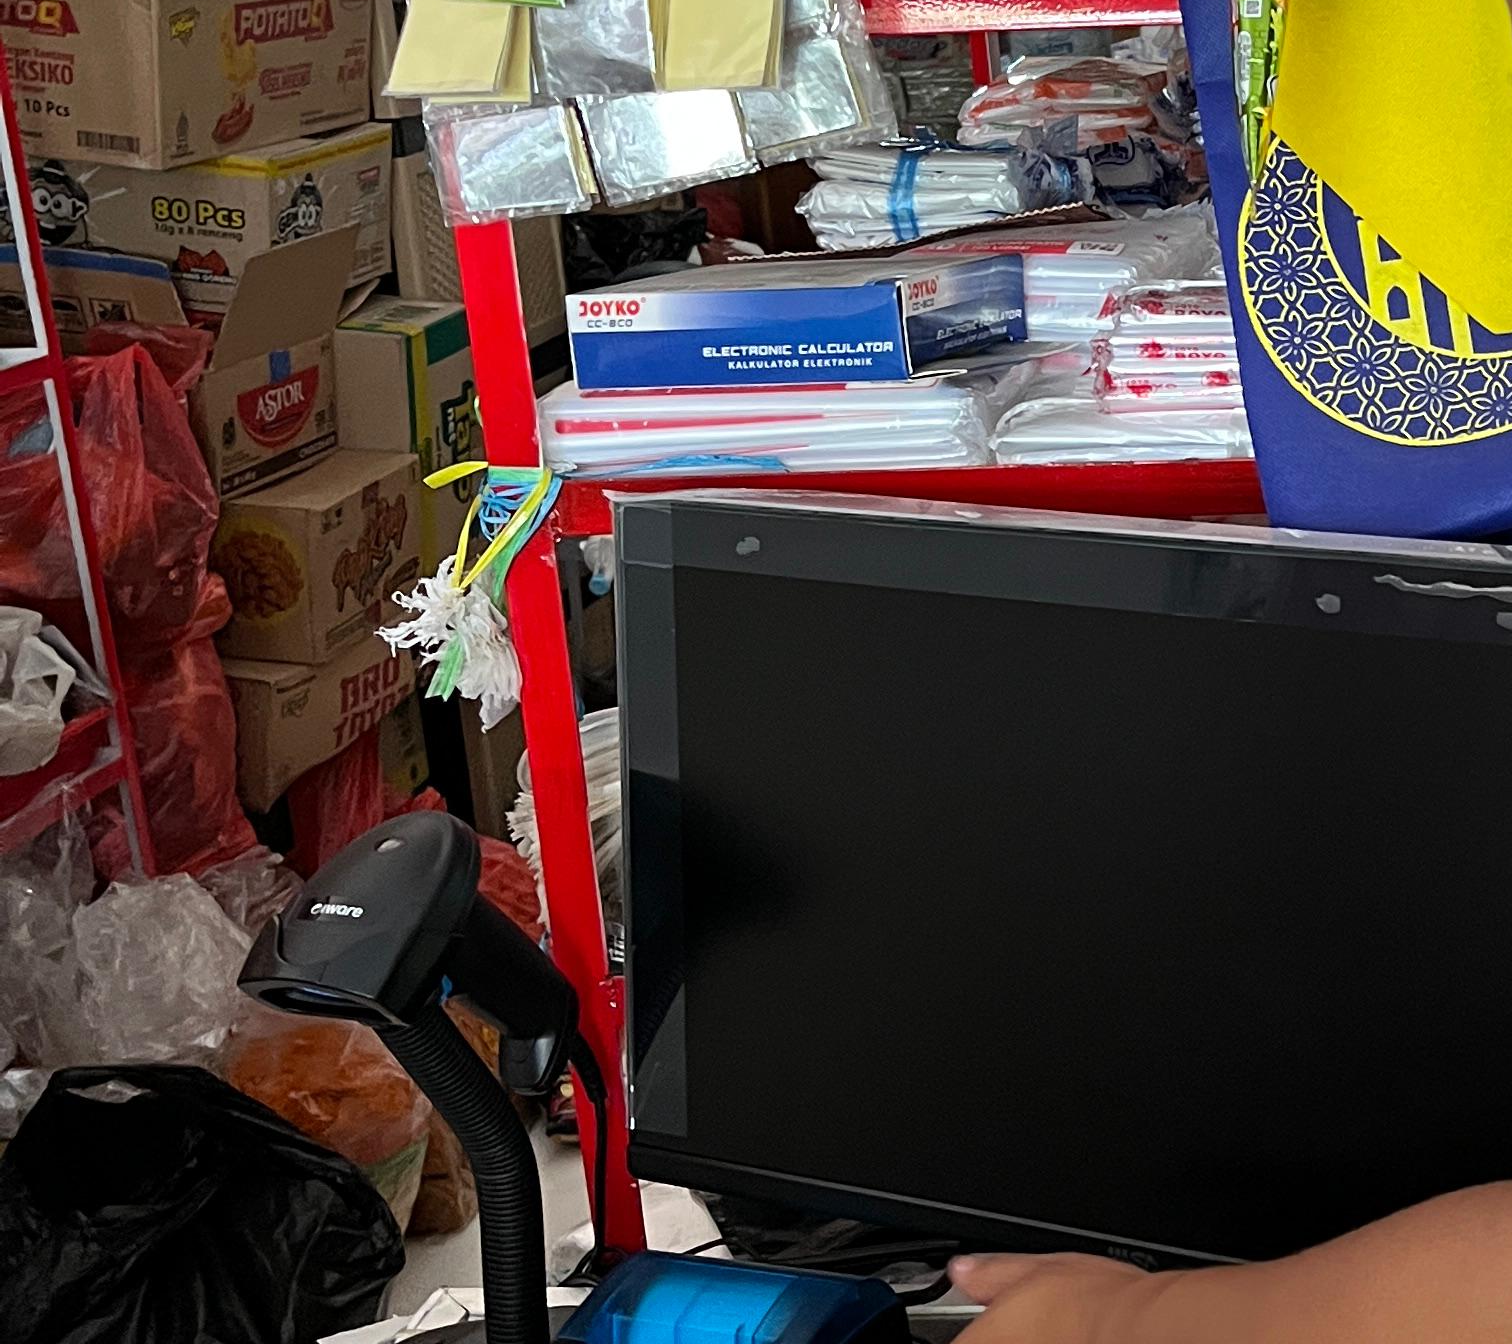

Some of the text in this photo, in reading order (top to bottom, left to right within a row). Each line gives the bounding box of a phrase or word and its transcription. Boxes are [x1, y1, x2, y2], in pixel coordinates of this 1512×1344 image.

[11, 57, 74, 87] EKSIKO
[24, 98, 70, 118] 10 Pcs
[153, 197, 246, 230] 80 Pcs
[908, 279, 938, 300] JOYKO
[578, 299, 642, 317] JOYKO
[702, 341, 894, 358] ELECTRONIC CALCULATOR
[727, 357, 874, 371] KALKULATOR ELEKTRONIK
[254, 384, 306, 423] ASTOR
